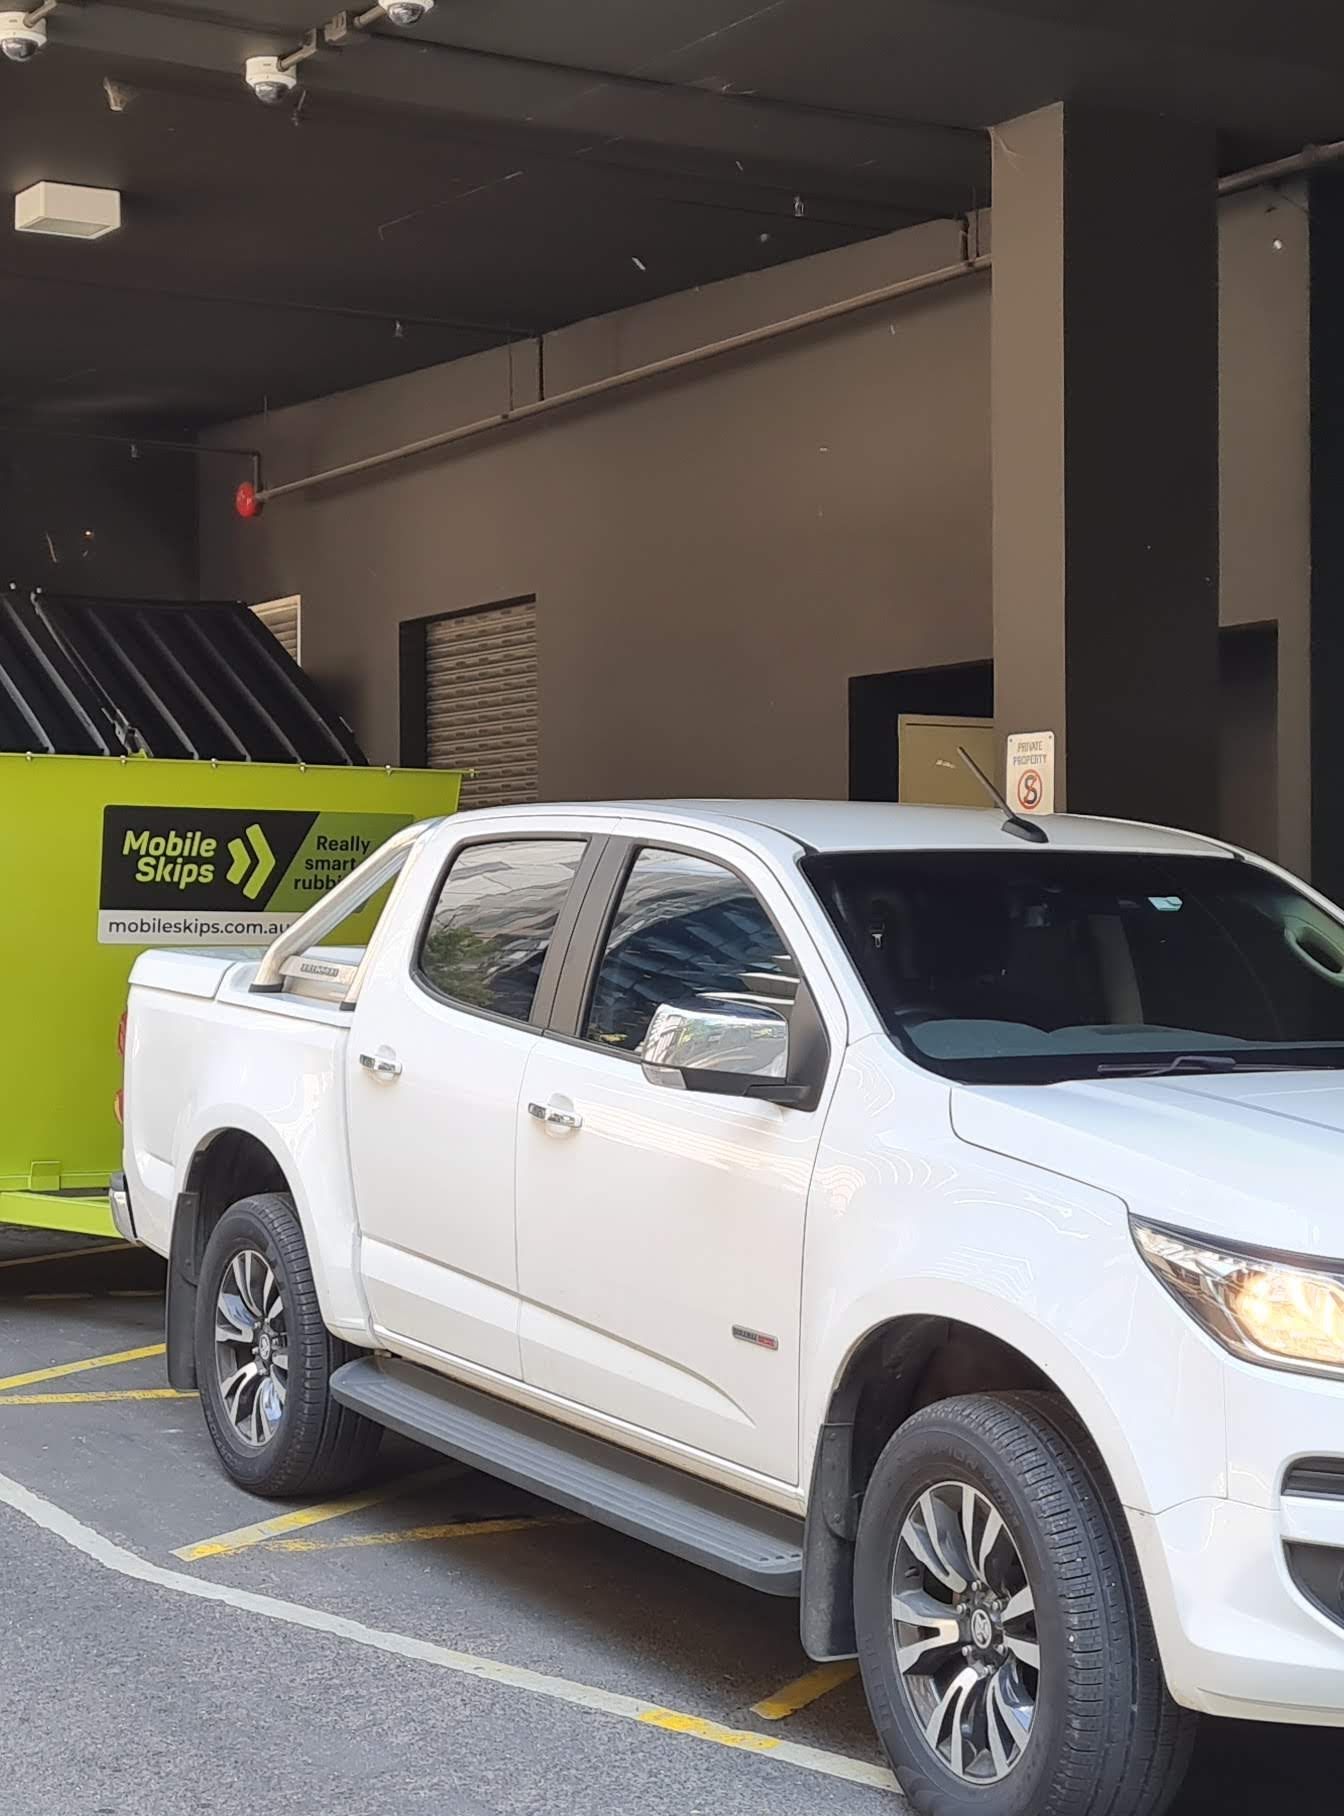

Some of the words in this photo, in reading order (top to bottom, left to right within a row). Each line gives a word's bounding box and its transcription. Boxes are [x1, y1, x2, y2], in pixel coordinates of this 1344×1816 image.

[1017, 741, 1043, 753] PRIVATE
[1013, 754, 1047, 767] PROPERTY
[122, 830, 217, 858] Mobile
[316, 836, 371, 855] Really
[135, 856, 216, 890] Skips
[304, 857, 356, 872] smart
[108, 918, 290, 937] mobileskips.com.au
